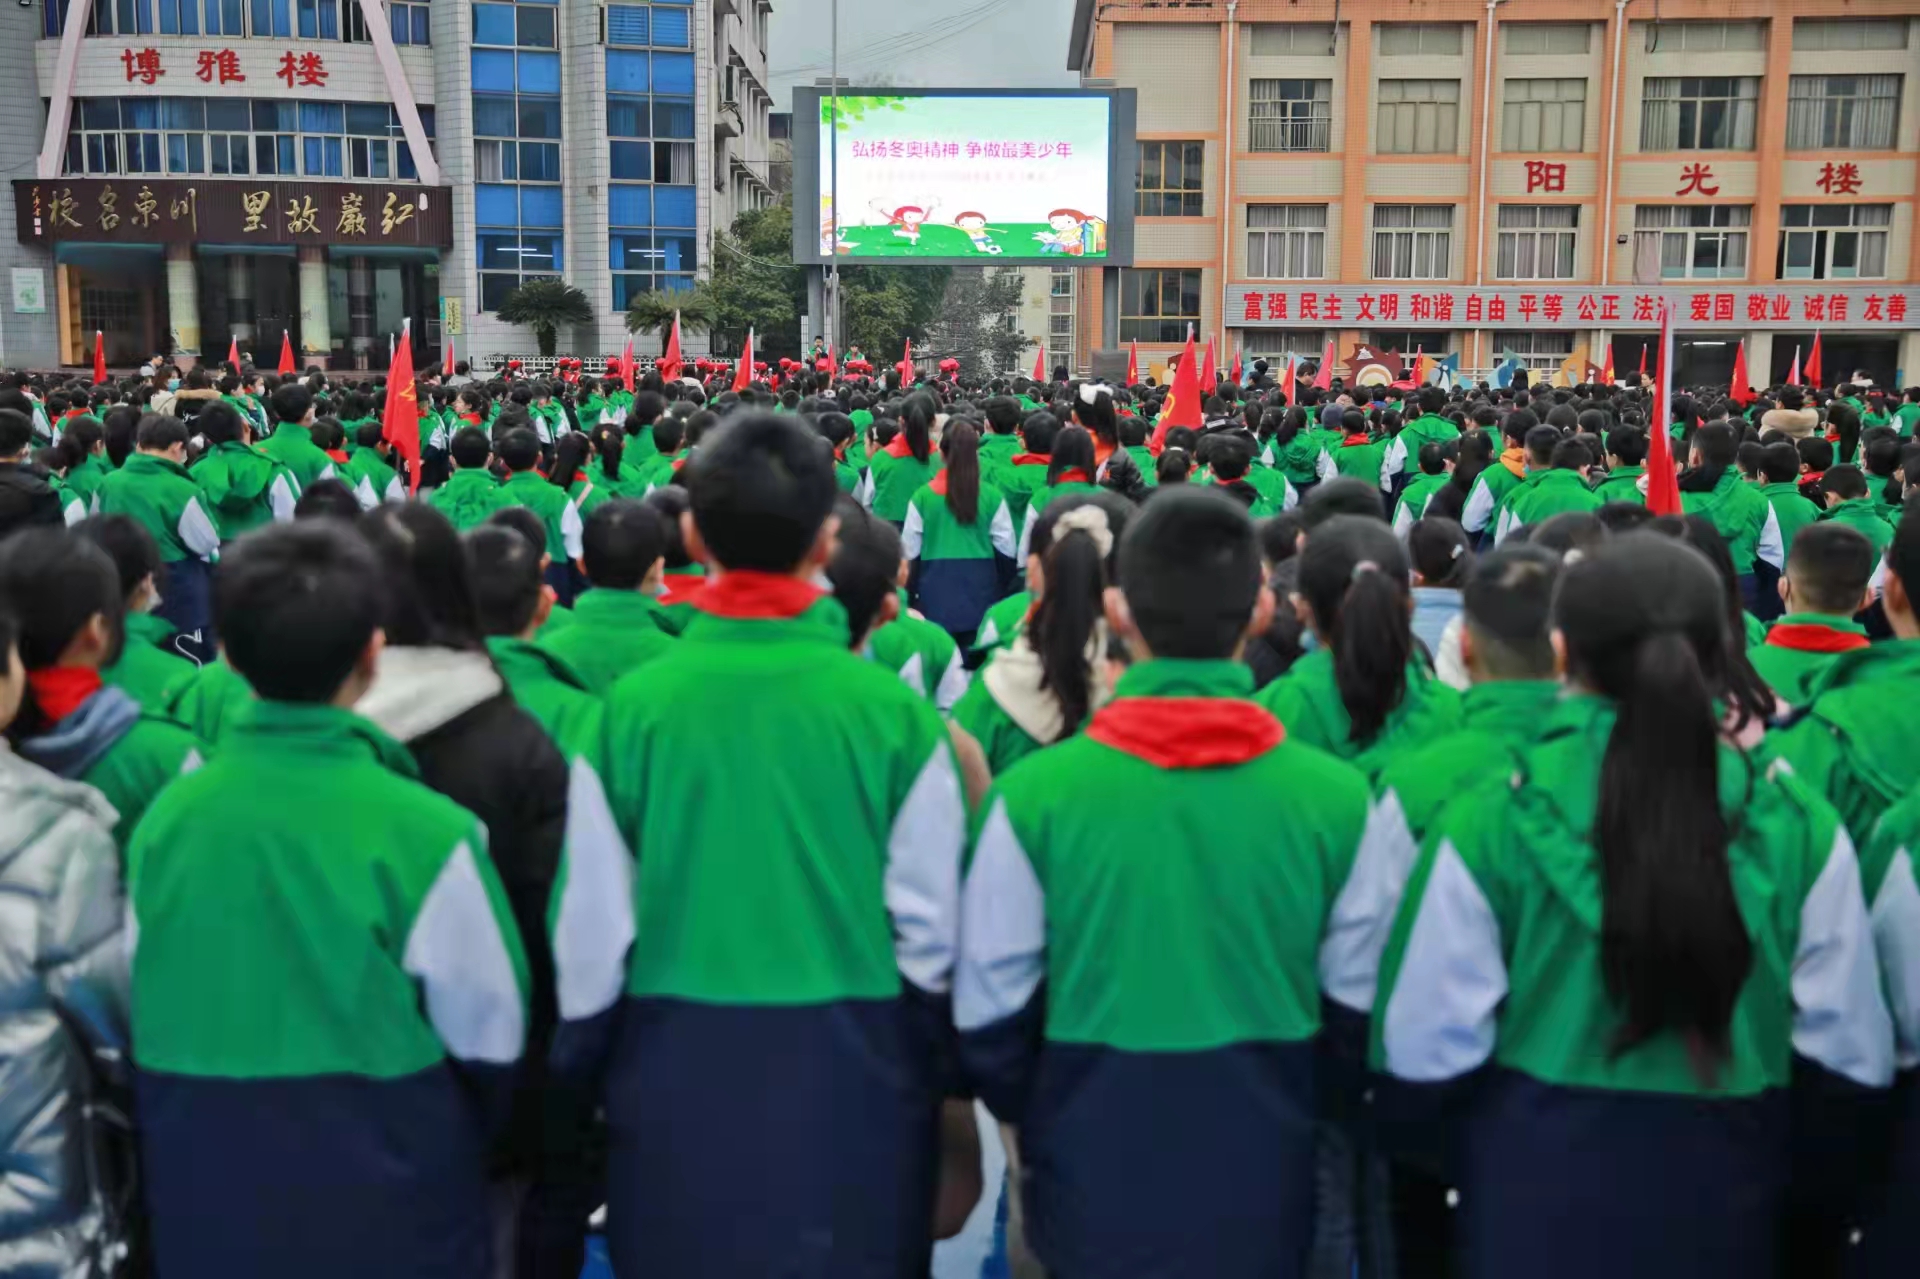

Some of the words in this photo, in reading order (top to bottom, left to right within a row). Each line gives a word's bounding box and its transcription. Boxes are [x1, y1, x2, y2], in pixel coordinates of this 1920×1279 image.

[121, 48, 329, 88] 博雅楼
[852, 141, 959, 158] 弘扬冬奥精神
[966, 141, 1073, 158] 争做最美少年
[1524, 161, 1863, 196] 阳光楼
[1243, 291, 1288, 321] 富强
[1299, 291, 1343, 321] 民主
[1356, 293, 1399, 321] 文明
[1410, 293, 1455, 321] 和谐
[1466, 293, 1507, 322] 自由
[1518, 293, 1564, 322] 平等
[1577, 294, 1621, 321] 公正
[1690, 292, 1736, 321] 爱国
[1746, 293, 1791, 321] 敬业
[1803, 293, 1849, 322] 诚信
[1863, 293, 1907, 322] 友善
